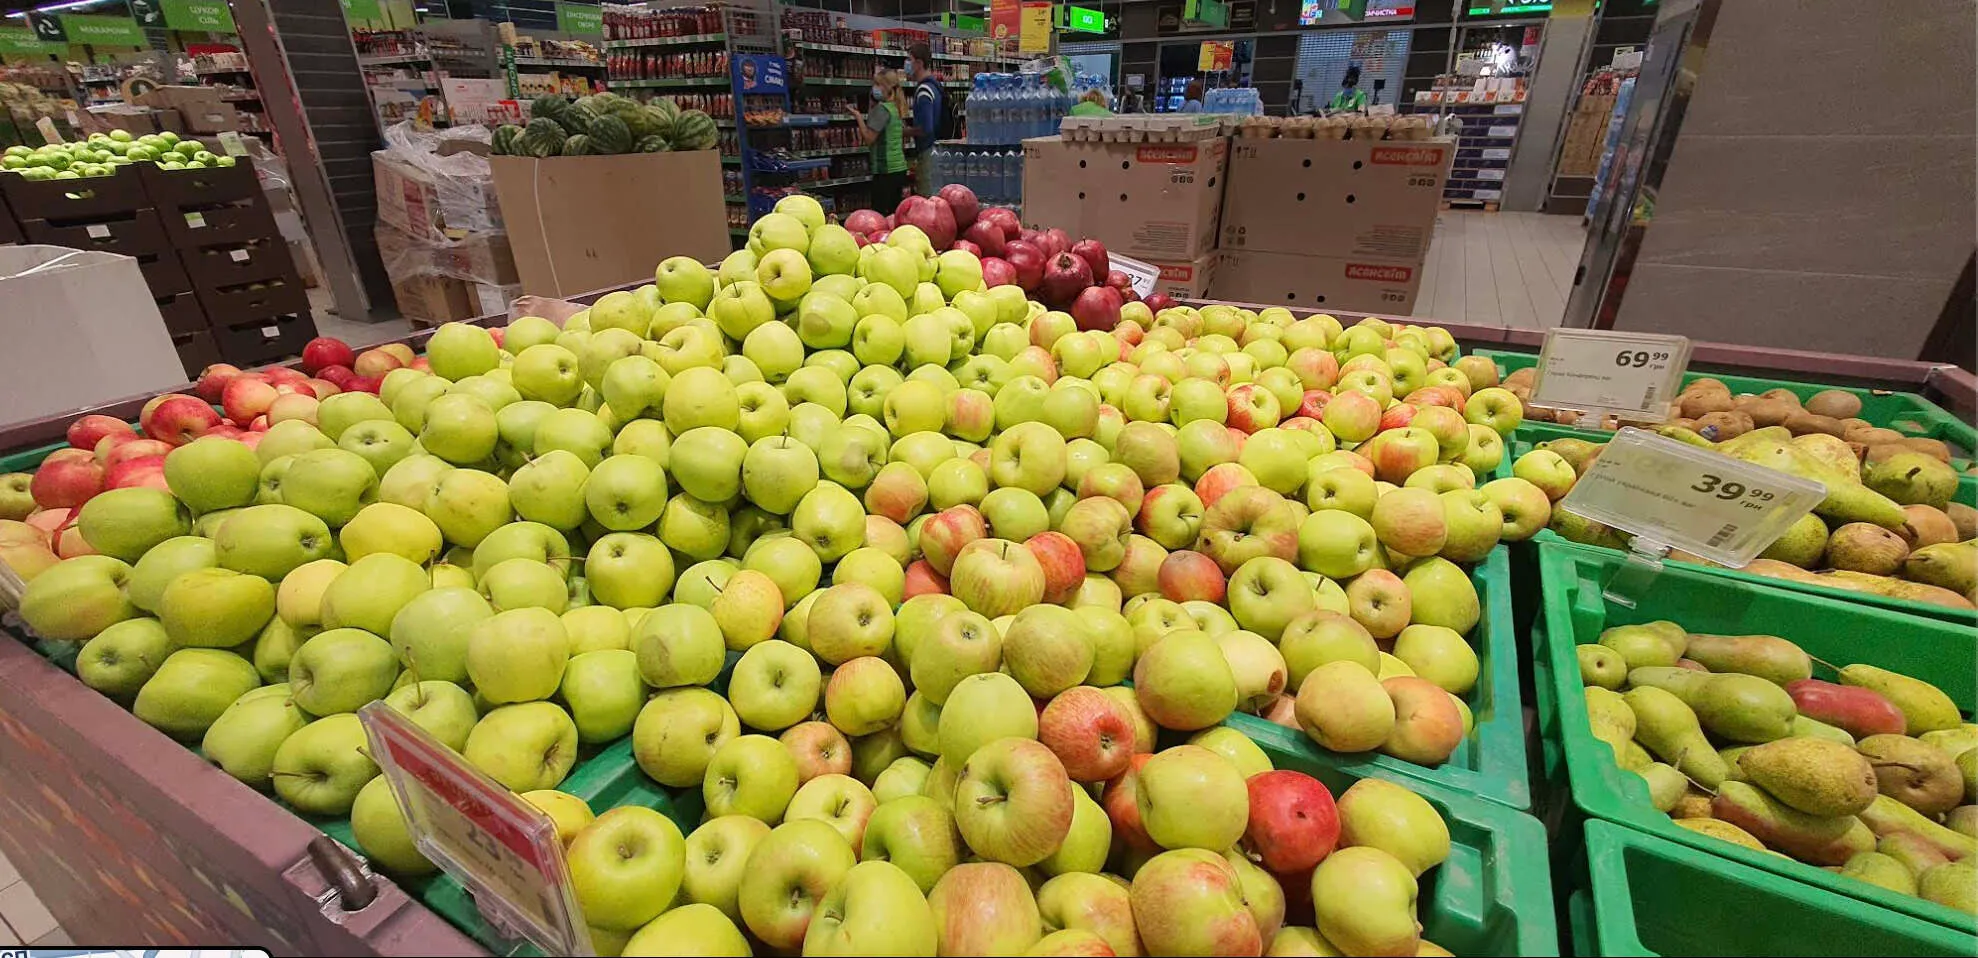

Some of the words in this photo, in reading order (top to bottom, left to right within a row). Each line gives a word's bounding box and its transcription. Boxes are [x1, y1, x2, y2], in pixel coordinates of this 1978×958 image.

[1616, 350, 1650, 368] 69
[1652, 352, 1669, 361] 99
[1691, 474, 1746, 500] 39
[1749, 489, 1774, 501] 99
[1740, 500, 1763, 511] грн
